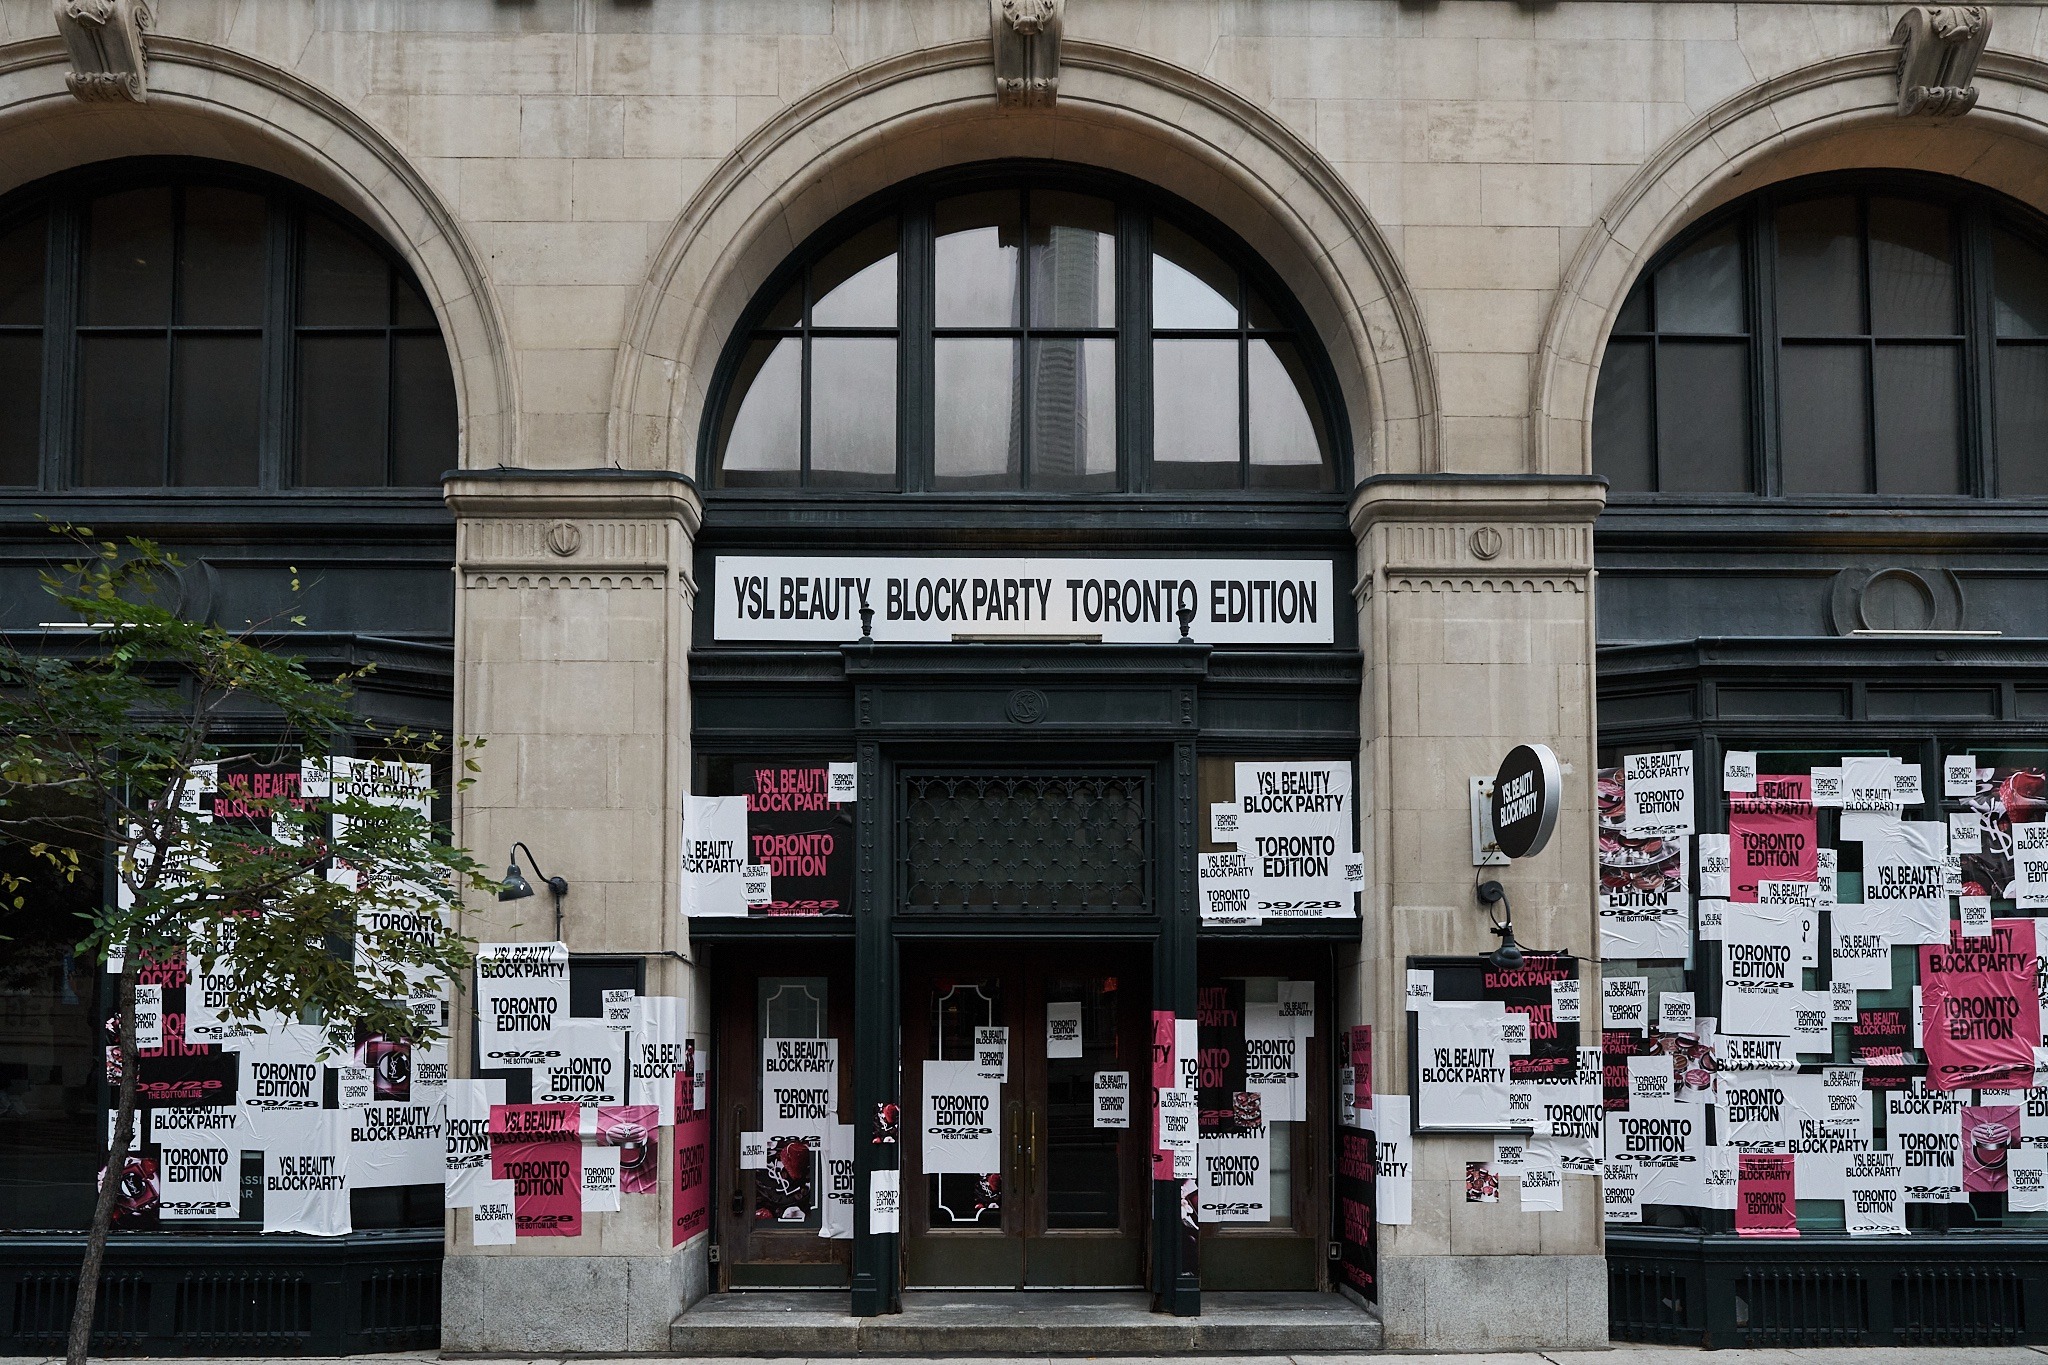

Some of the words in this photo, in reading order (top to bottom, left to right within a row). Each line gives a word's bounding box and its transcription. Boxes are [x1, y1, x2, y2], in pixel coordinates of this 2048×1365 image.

[734, 576, 774, 620] YSL
[780, 577, 871, 621] BEAUTY
[887, 578, 968, 621] BLOCK
[973, 579, 1052, 622] PARTY
[1067, 579, 1198, 623] TORONTO
[1210, 580, 1318, 624] EDITION
[1636, 757, 1650, 769] YSL
[1651, 754, 1681, 768] BEAUTY
[1628, 769, 1657, 780] BLOCK
[1659, 766, 1689, 778] PARTY
[755, 770, 779, 793] YSL
[781, 769, 829, 793] BEAUTY
[1257, 772, 1280, 795] YSL
[1282, 771, 1330, 794] BEAUTY
[1502, 783, 1511, 804] YSL
[1512, 770, 1534, 800] BEAUTY
[337, 781, 382, 798] BLOCK
[1634, 789, 1684, 803] TORONTO
[1244, 795, 1292, 813] BLOCK
[1296, 795, 1343, 813] PARTY
[1501, 801, 1519, 828] BLOCK
[1518, 791, 1538, 820] PARTY
[1639, 802, 1680, 814] EDITION
[752, 835, 834, 856] TORONTO
[1255, 836, 1335, 856] TORONTO
[1741, 833, 1804, 849] TORONTO
[1208, 855, 1219, 868] YSL
[1221, 855, 1246, 867] BEAUTY
[1747, 850, 1799, 866] EDITION
[1201, 867, 1227, 878] BLOCK
[1228, 867, 1253, 877] PARTY
[1264, 857, 1328, 877] EDITION
[1878, 866, 1896, 884] YSL
[1899, 866, 1942, 884] BEAUTY
[1207, 889, 1250, 901] TORONTO
[1769, 884, 1783, 897] YSL
[1785, 884, 1808, 897] BEAUTY
[1212, 901, 1247, 912] EDITION
[371, 913, 443, 932] TORONTO
[1840, 935, 1852, 948] YSL
[1854, 935, 1880, 948] BEAUTY
[1728, 945, 1790, 961] TORONTO
[1833, 949, 1861, 958] BLOCK
[1861, 949, 1888, 958] PARTY
[1733, 962, 1785, 979] EDITION
[1929, 954, 1976, 974] BLOCK
[1977, 953, 2028, 973] PARTY
[481, 964, 521, 978] BLOCK
[525, 964, 565, 978] PARTY
[1485, 972, 1526, 989] BLOCK
[1610, 982, 1622, 990] YSL
[1623, 981, 1640, 990] BEAUTY
[1726, 980, 1794, 988] 09/28
[491, 997, 558, 1014] TORONTO
[1609, 1005, 1642, 1013] TORONTO
[1944, 997, 2019, 1018] TORONTO
[1612, 1012, 1638, 1020] EDITION
[1796, 1010, 1826, 1018] TORONTO
[1860, 1013, 1873, 1025] YSL
[1874, 1013, 1899, 1024] BEAUTY
[497, 1015, 551, 1032] EDITION
[1050, 1020, 1077, 1028] TORONTO
[1798, 1018, 1823, 1026] EDITION
[1854, 1025, 1878, 1035] BLOCK
[1880, 1025, 1906, 1034] PARTY
[1950, 1019, 2013, 1040] EDITION
[777, 1042, 793, 1058] YSL
[795, 1041, 828, 1058] BEAUTY
[1434, 1048, 1451, 1068] YSL
[1454, 1049, 1494, 1068] BEAUTY
[252, 1063, 316, 1081] TORONTO
[767, 1059, 802, 1072] BLOCK
[804, 1059, 834, 1072] PARTY
[1099, 1075, 1109, 1083] YSL
[1109, 1075, 1123, 1083] BEAUTY
[1423, 1068, 1463, 1082] BLOCK
[1465, 1068, 1505, 1082] PARTY
[257, 1081, 309, 1097] EDITION
[551, 1075, 605, 1092] EDITION
[774, 1089, 828, 1103] TORONTO
[931, 1095, 989, 1110] TORONTO
[246, 1100, 320, 1108] 09/28
[780, 1104, 827, 1118] EDITION
[1101, 1103, 1122, 1111] EDITION
[155, 1115, 195, 1129] BLOCK
[197, 1115, 236, 1129] PARTY
[364, 1108, 383, 1127] YSL
[386, 1107, 430, 1125] BEAUTY
[504, 1111, 522, 1132] YSL
[523, 1110, 565, 1131] BEAUTY
[937, 1111, 983, 1125] EDITION
[351, 1126, 396, 1142] BLOCK
[398, 1125, 442, 1140] PARTY
[1619, 1119, 1691, 1136] TORONTO
[1626, 1136, 1684, 1152] EDITION
[163, 1148, 228, 1165] TORONTO
[1615, 1154, 1696, 1162] 09/28
[1853, 1154, 1866, 1166] YSL
[1868, 1154, 1894, 1165] BEAUTY
[279, 1157, 297, 1176] YSL
[300, 1156, 336, 1174] BEAUTY
[503, 1162, 570, 1179] TORONTO
[584, 1168, 615, 1176] TORONTO
[1846, 1167, 1872, 1177] BLOCK
[1874, 1167, 1902, 1176] PARTY
[169, 1165, 222, 1182] EDITION
[586, 1176, 612, 1184] EDITION
[1739, 1171, 1763, 1180] BLOCK
[1764, 1171, 1790, 1180] PARTY
[268, 1176, 308, 1191] BLOCK
[309, 1175, 346, 1190] PARTY
[1744, 1192, 1786, 1203] TORONTO
[1852, 1190, 1896, 1201] TORONTO
[480, 1205, 493, 1214] YSL
[494, 1204, 508, 1213] BEAUTY
[1748, 1203, 1783, 1214] EDITION
[1857, 1202, 1893, 1213] EDITION
